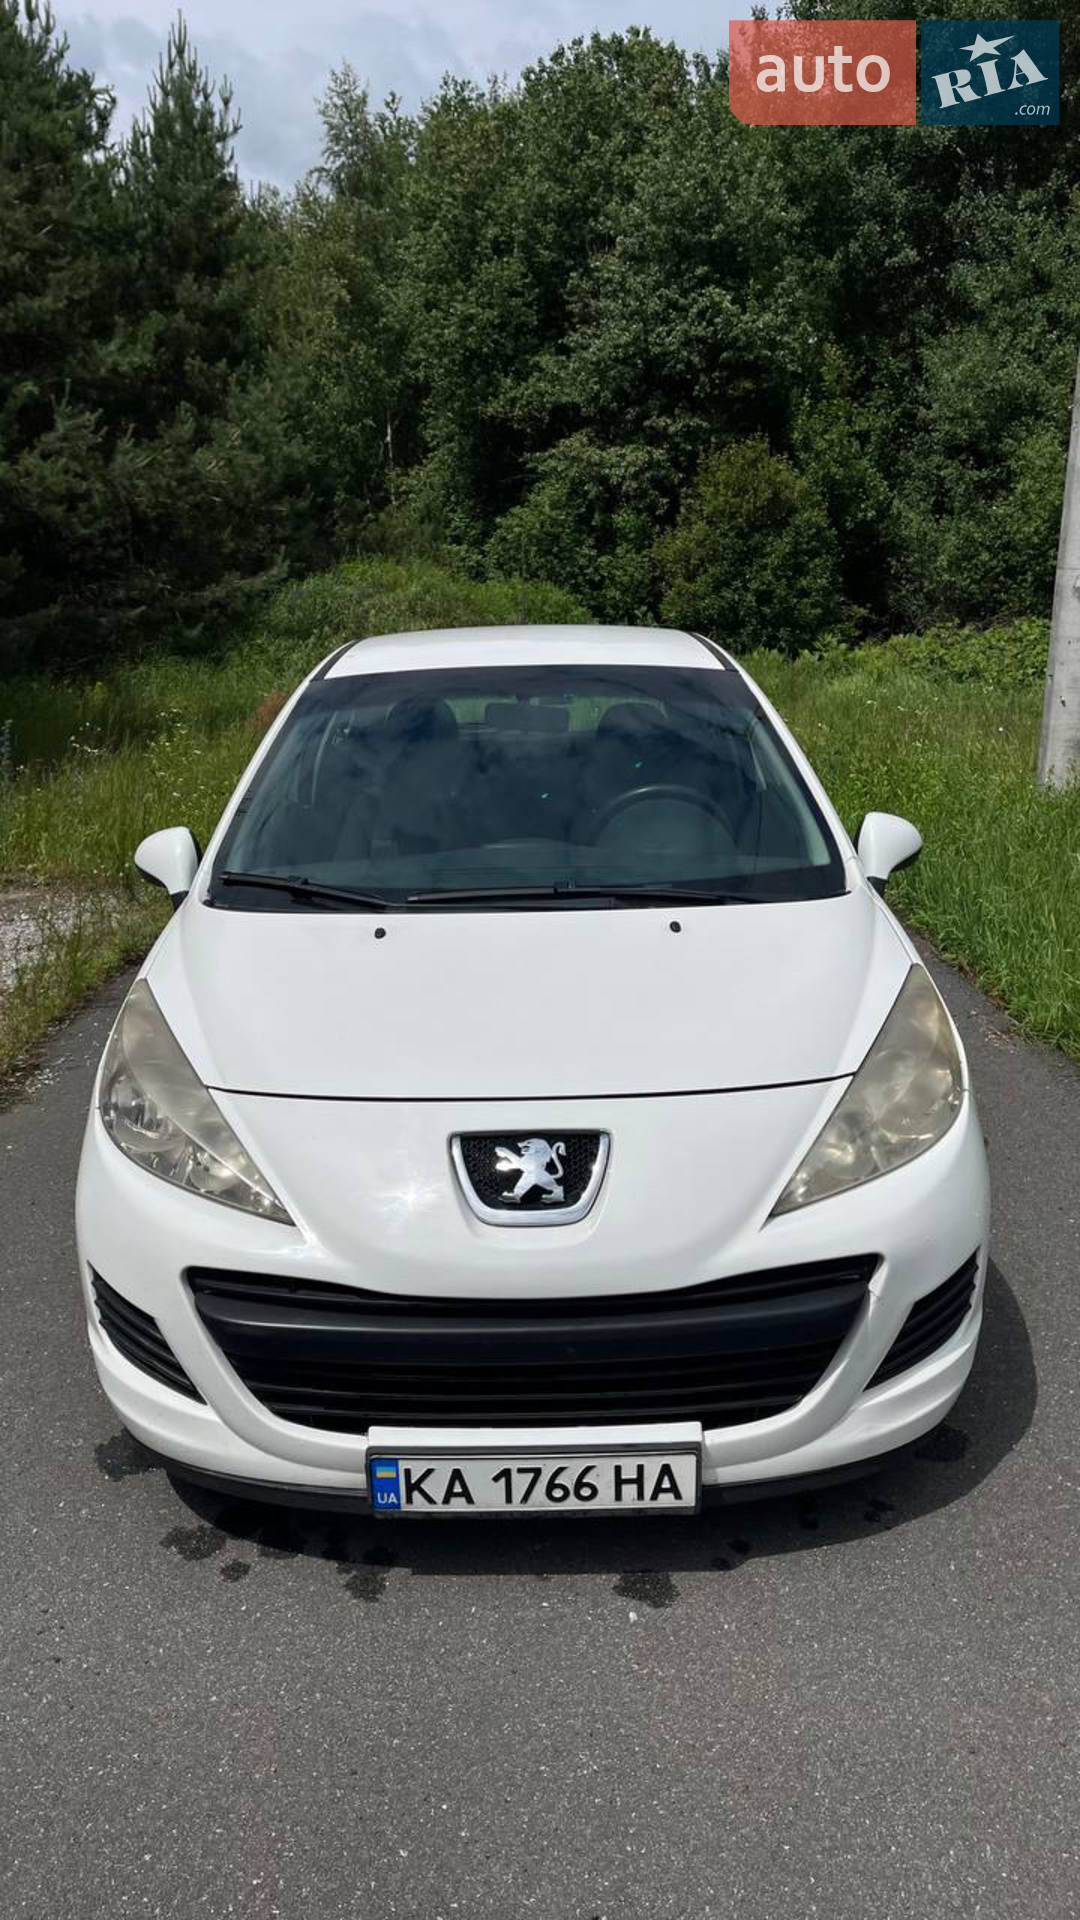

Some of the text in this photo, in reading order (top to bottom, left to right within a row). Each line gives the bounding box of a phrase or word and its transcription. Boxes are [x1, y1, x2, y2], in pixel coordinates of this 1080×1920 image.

[403, 1463, 683, 1505] KA 1766 HA
[377, 1492, 398, 1504] UA
